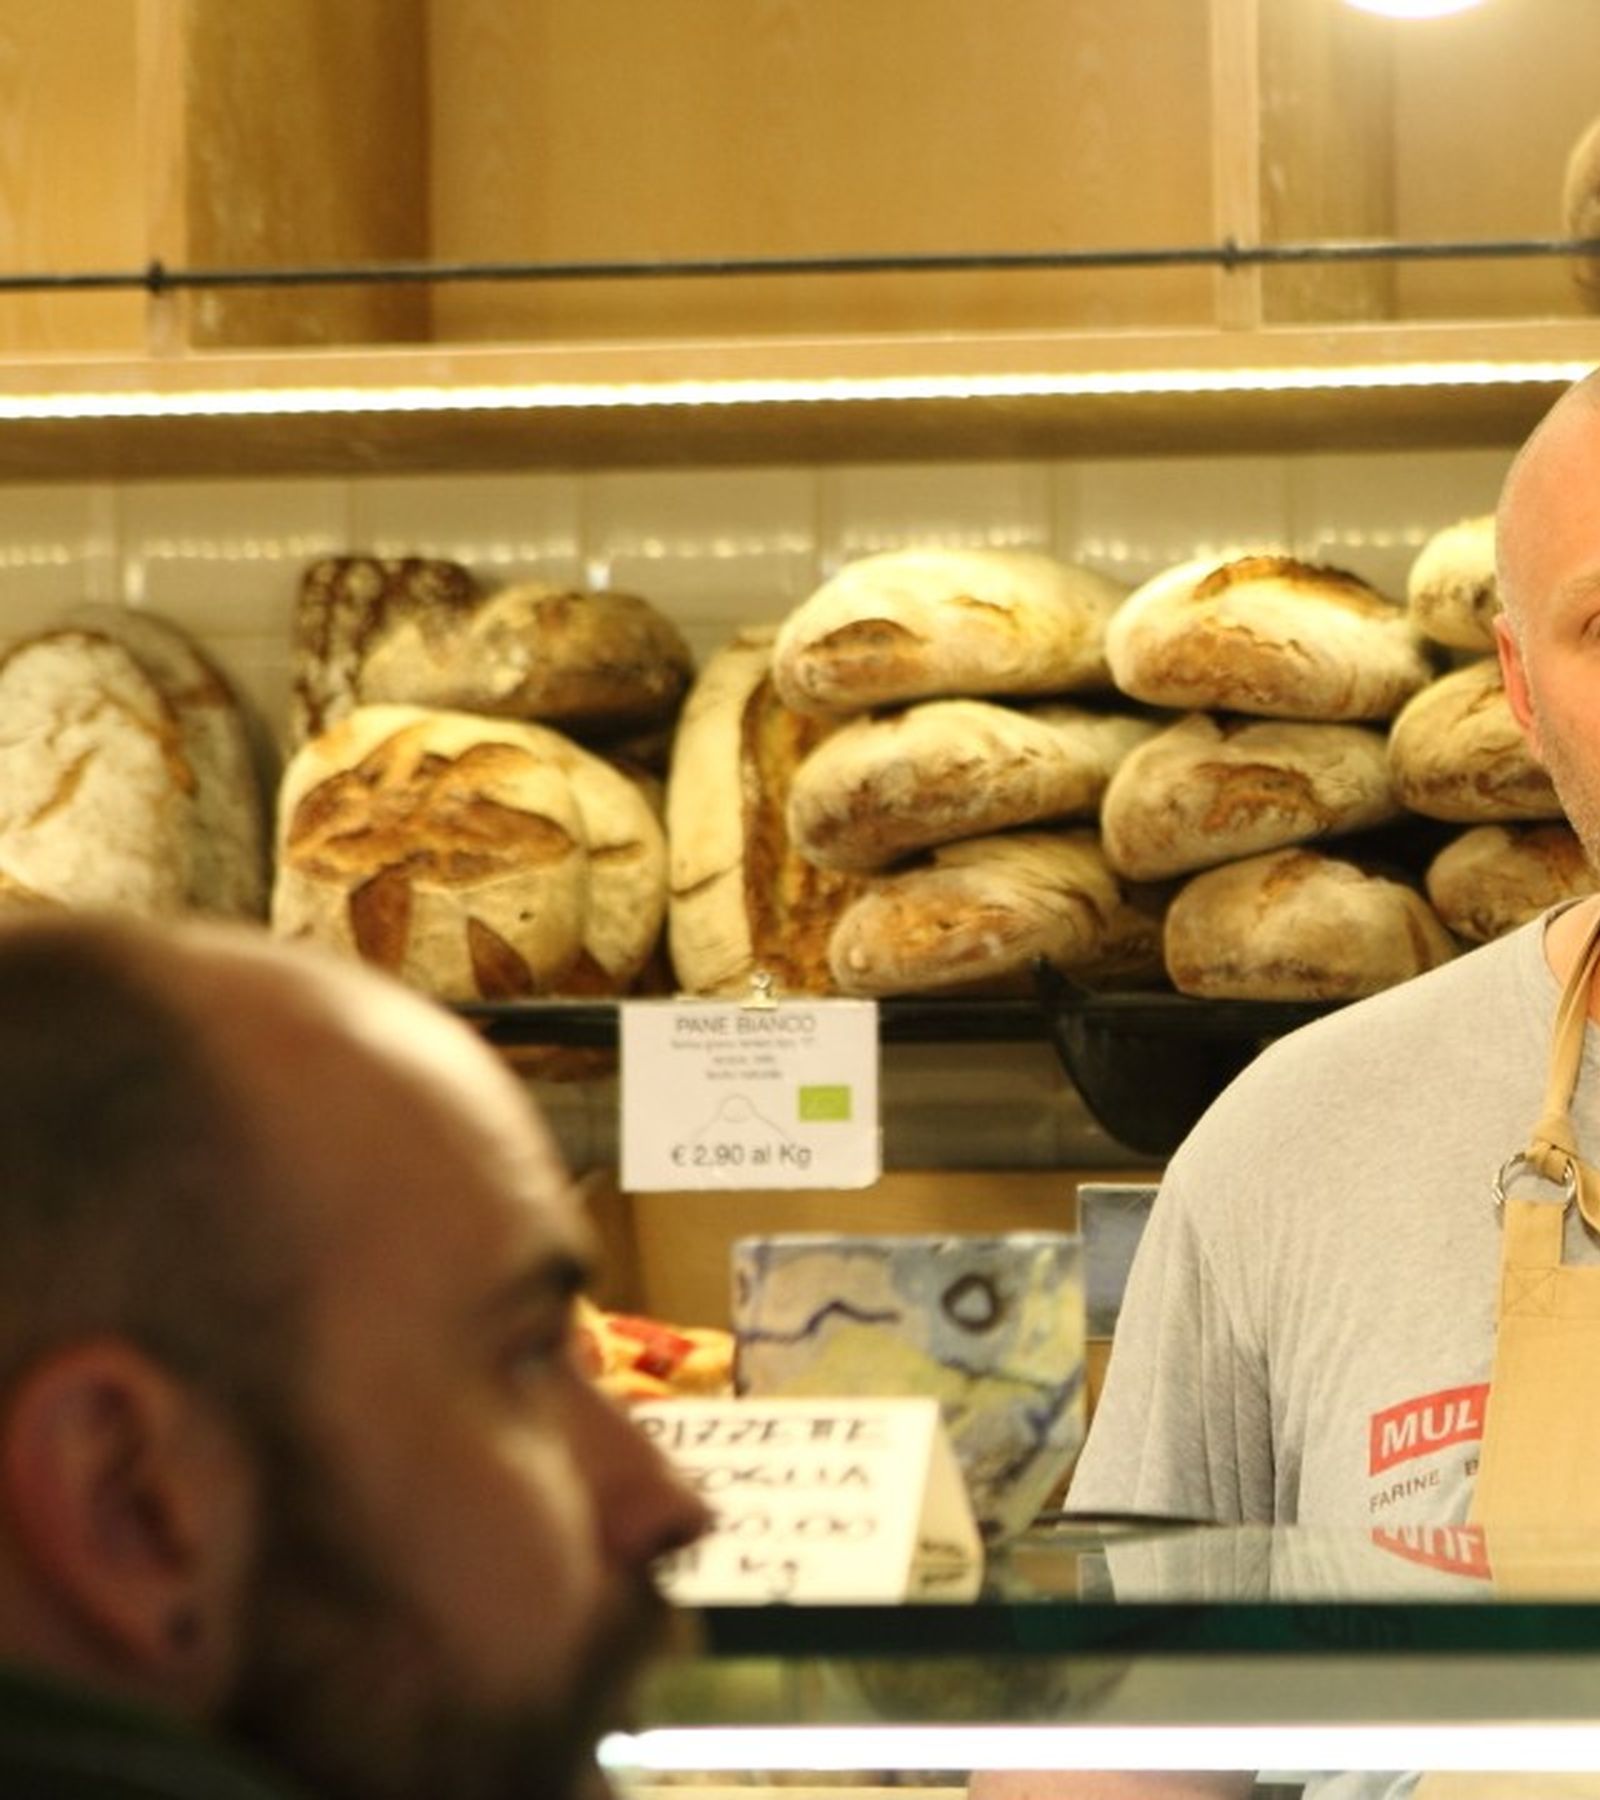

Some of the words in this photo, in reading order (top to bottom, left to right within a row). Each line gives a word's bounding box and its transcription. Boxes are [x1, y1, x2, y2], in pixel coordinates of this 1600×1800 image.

[675, 1015, 730, 1034] PANE
[736, 1014, 817, 1034] BIANCO
[671, 1144, 687, 1168] €
[750, 1143, 772, 1166] al
[778, 1142, 812, 1171] Kg
[1380, 1398, 1480, 1460] MUL
[1369, 1469, 1441, 1514] FARINE
